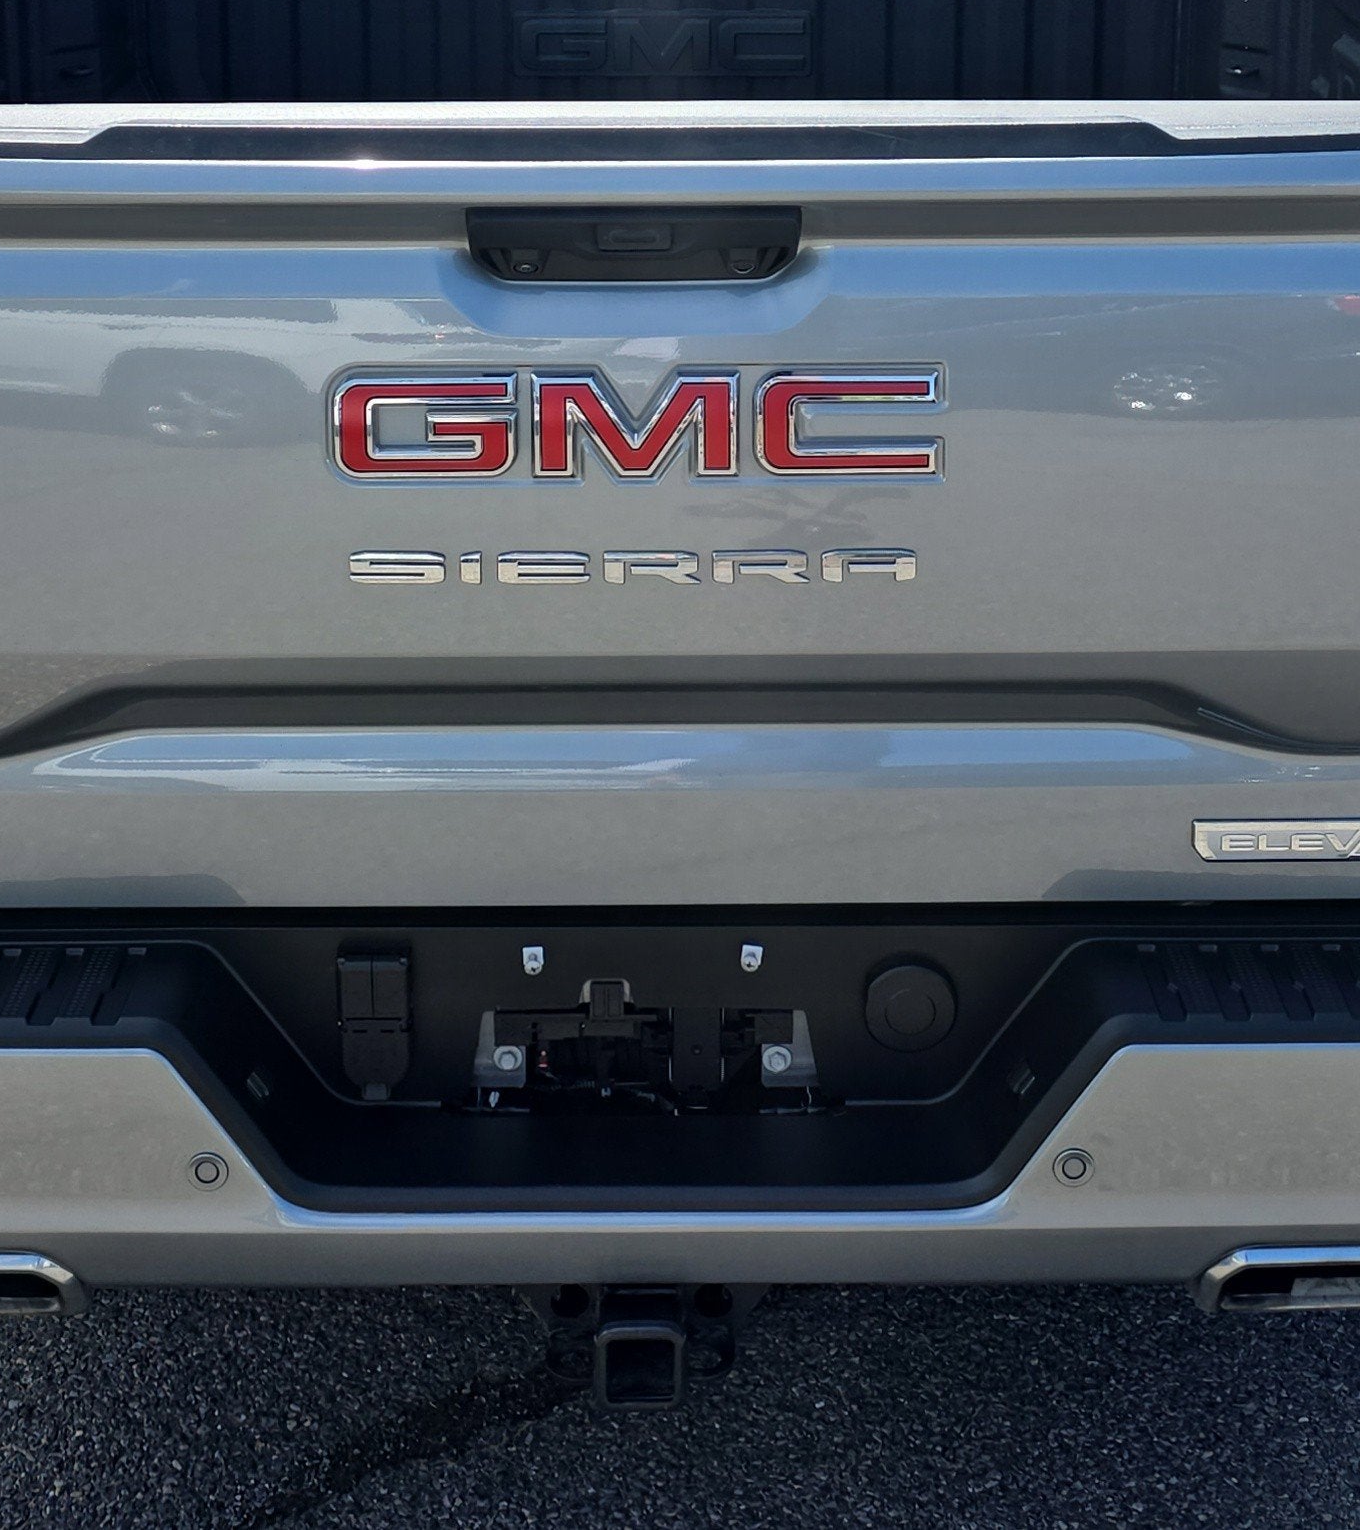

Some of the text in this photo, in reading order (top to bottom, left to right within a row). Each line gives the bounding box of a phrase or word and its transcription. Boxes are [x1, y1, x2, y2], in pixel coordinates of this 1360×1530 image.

[520, 17, 807, 71] GMC
[332, 370, 940, 478] GMC
[348, 547, 918, 585] SIERRA
